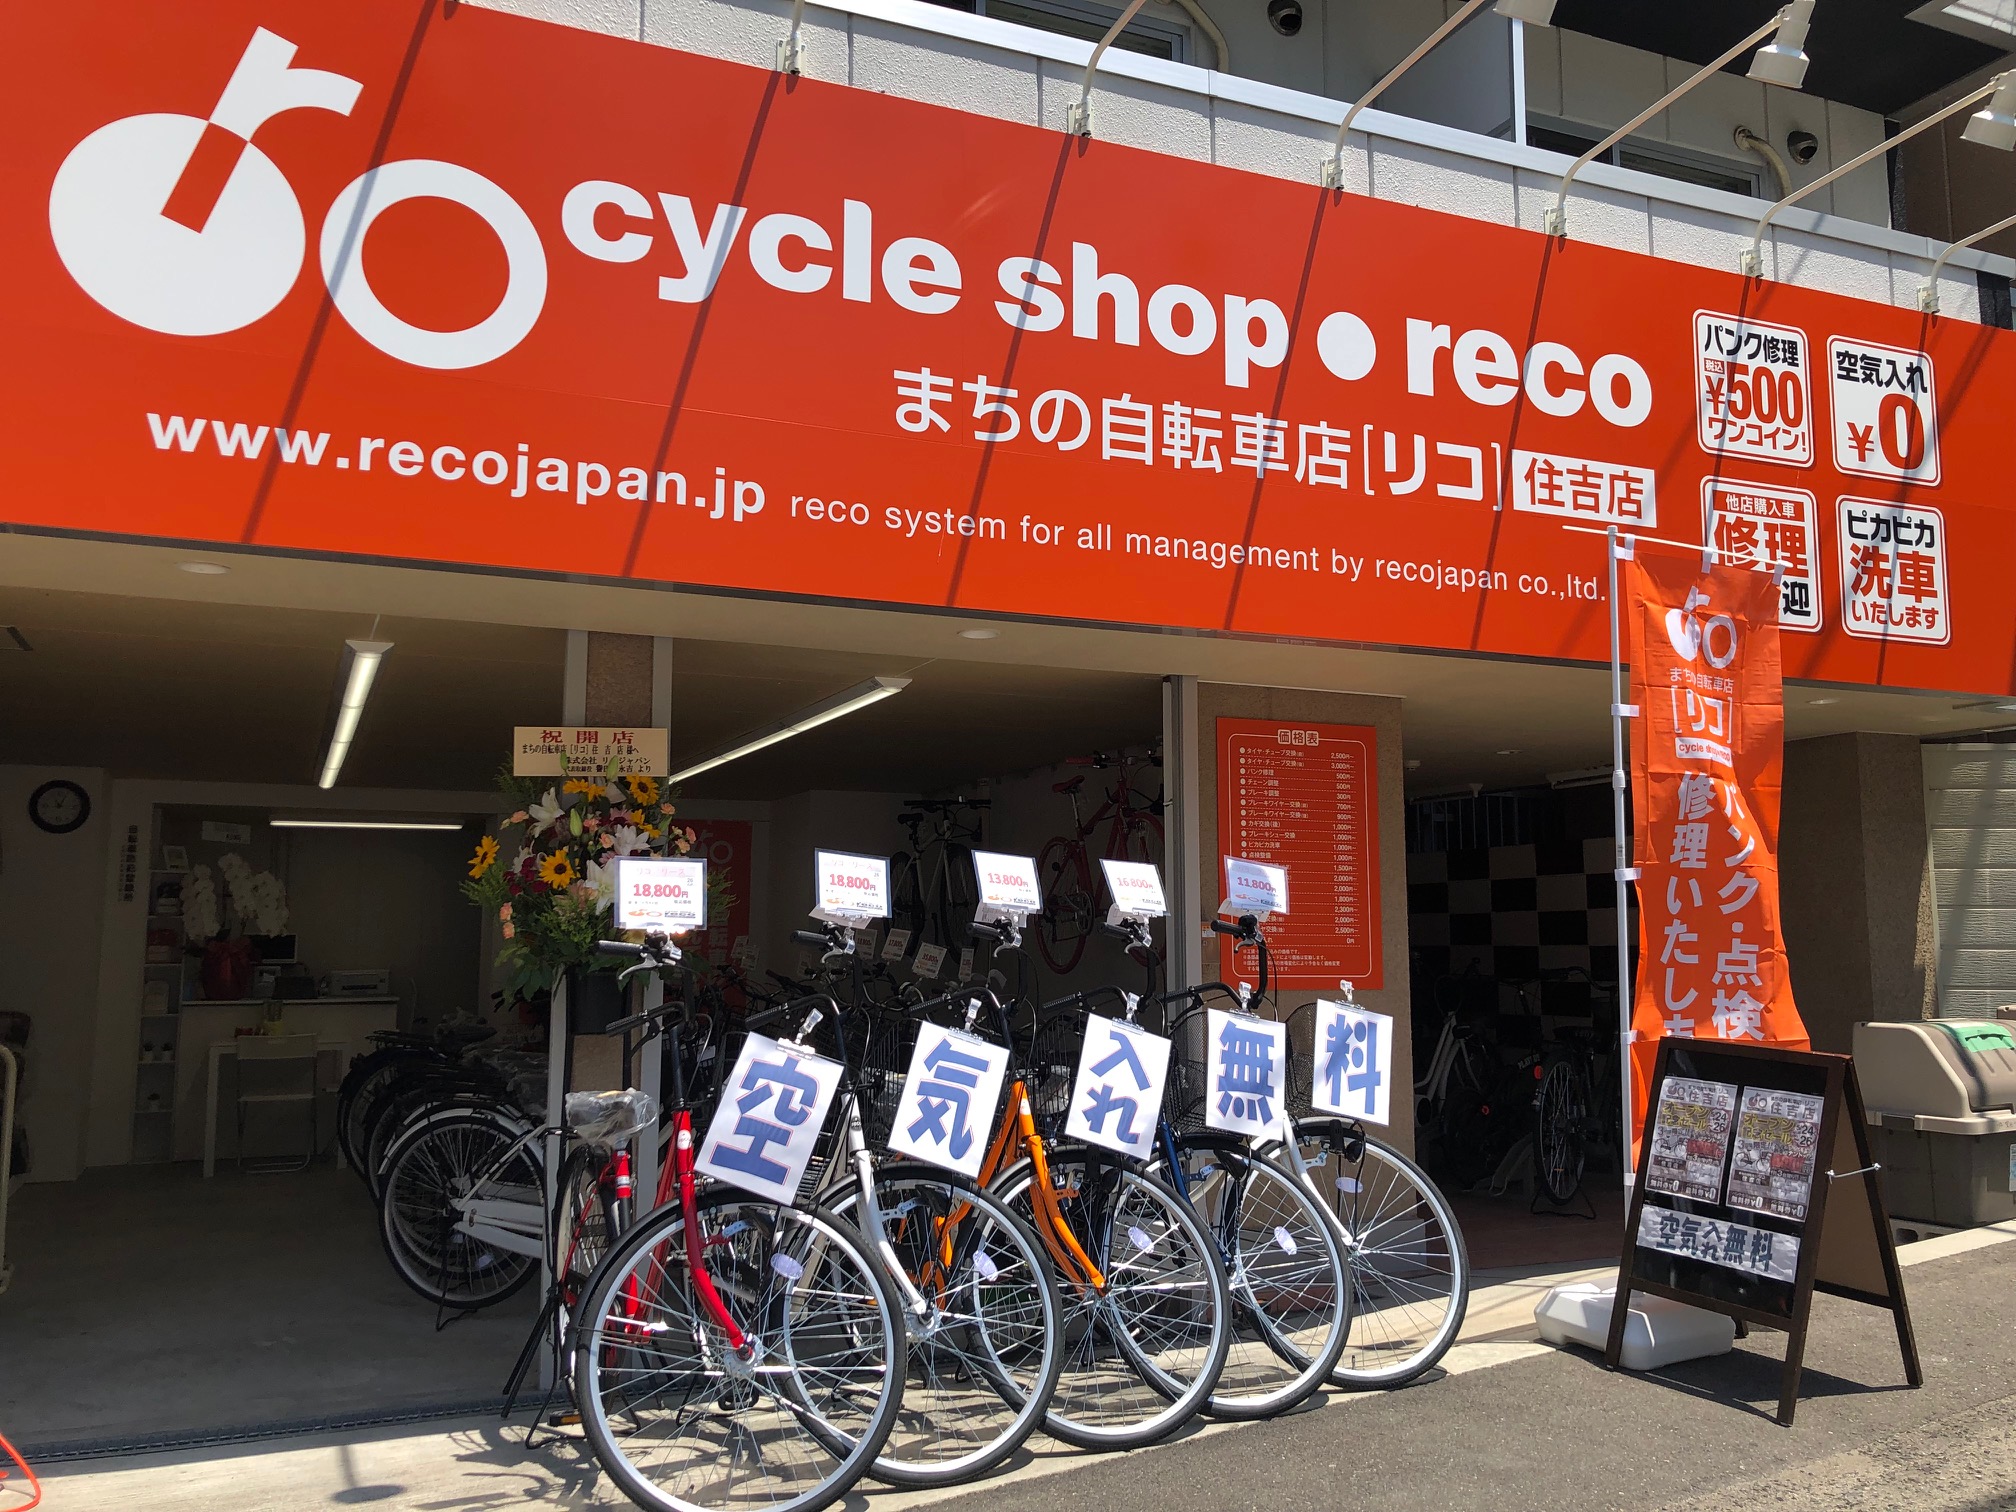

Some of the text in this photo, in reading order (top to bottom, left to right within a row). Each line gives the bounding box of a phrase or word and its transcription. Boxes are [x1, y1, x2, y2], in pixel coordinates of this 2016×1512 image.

[561, 180, 1653, 428] cycle shop reco
[1704, 325, 1800, 368] パンク修理
[1836, 349, 1929, 394] 空気入れ
[146, 411, 766, 522] www.recojapan.jp
[1524, 458, 1644, 520] 住吉店
[1725, 493, 1796, 520] 他店購入車
[791, 490, 870, 526] reco
[885, 504, 1006, 541] system
[1020, 514, 1065, 547] for
[1077, 523, 1112, 552] all
[1126, 532, 1320, 574] management
[1332, 548, 1365, 583] by
[1376, 556, 1507, 594] recojapan
[1846, 510, 1936, 549] ピカピカ
[1713, 513, 1809, 578] 修理
[1850, 543, 1938, 601] 洗車
[1851, 600, 1939, 631] いたします
[540, 729, 634, 744] 祝開店
[1278, 730, 1319, 746] 価格表
[1679, 742, 1704, 754] cycle
[602, 756, 651, 765] リジャパン
[633, 883, 688, 899] 18,800円
[829, 873, 876, 892] 18,800円
[1116, 876, 1154, 890] 16800円
[709, 1012, 1381, 1185] 空 気 入れ 無 料
[1663, 1101, 1711, 1118] オープン
[1689, 1090, 1729, 1107] 住吉店
[1770, 1102, 1815, 1120] 住吉店
[1744, 1113, 1796, 1132] オープン
